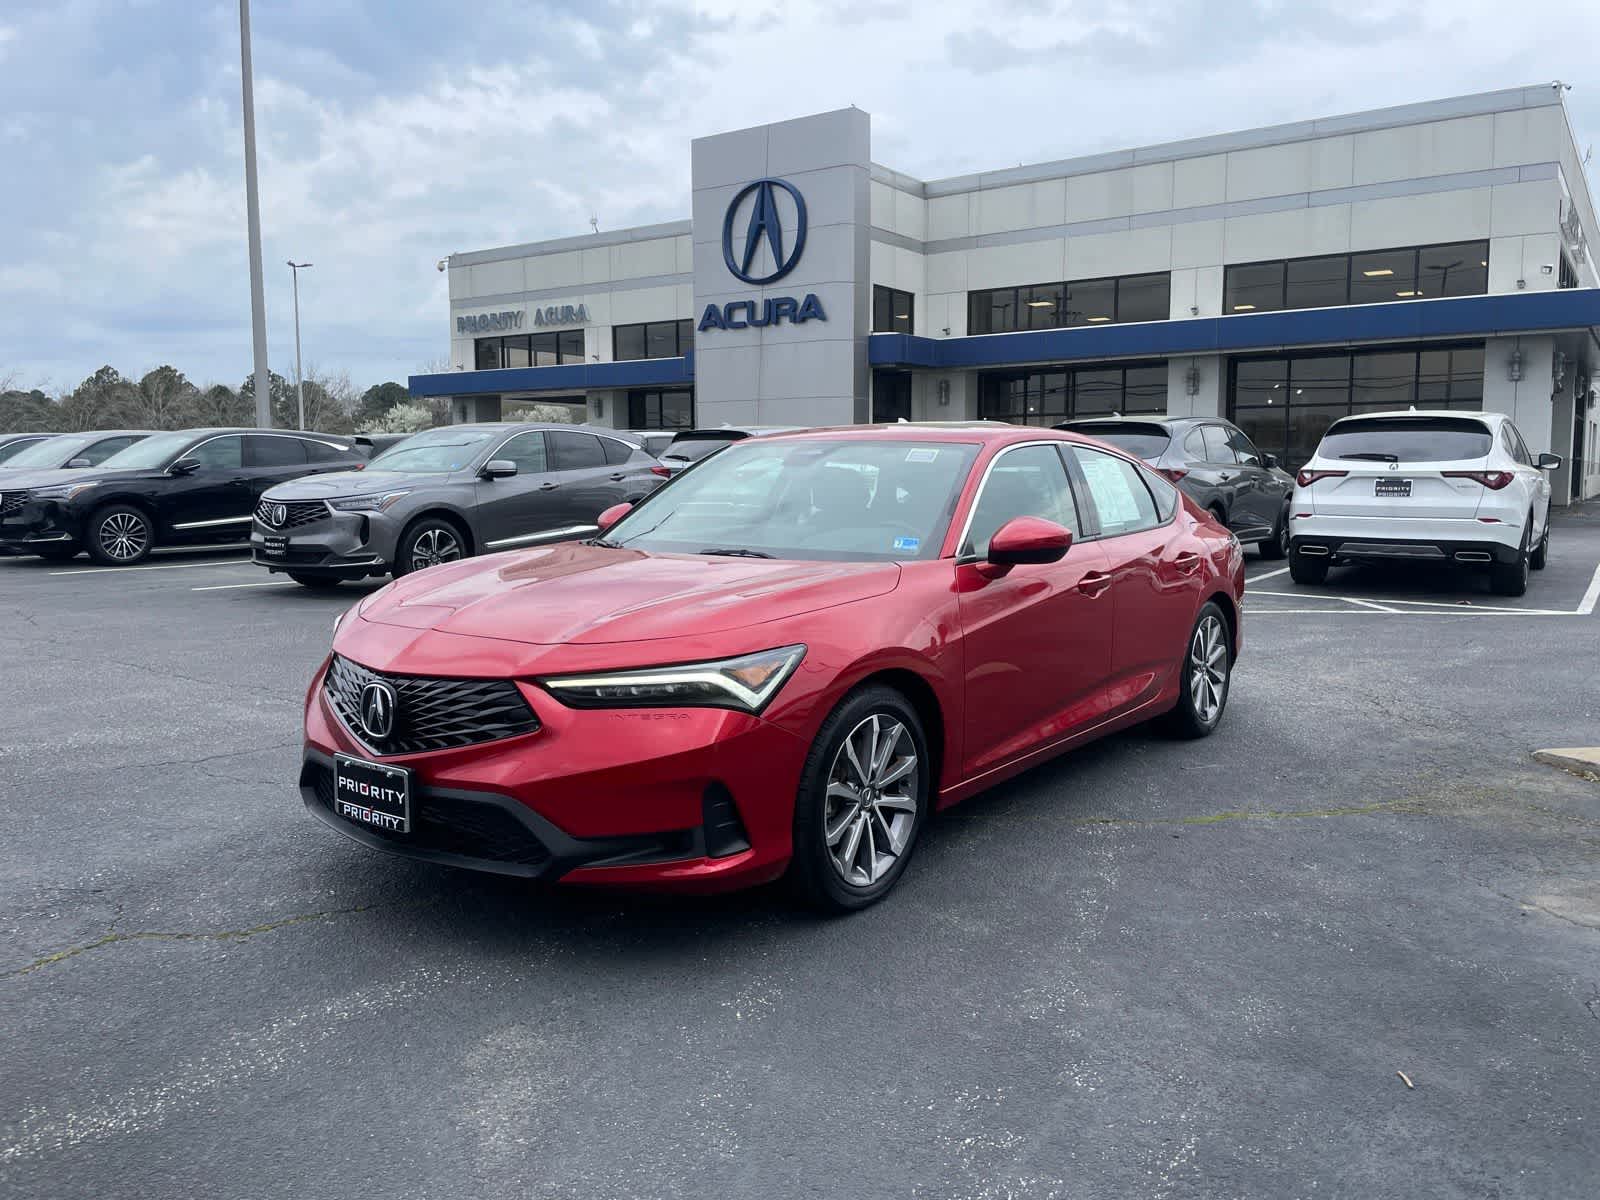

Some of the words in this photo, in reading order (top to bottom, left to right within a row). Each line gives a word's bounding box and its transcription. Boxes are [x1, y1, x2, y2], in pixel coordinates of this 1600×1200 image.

[534, 303, 589, 327] ACURA
[697, 293, 827, 331] ACURA
[608, 713, 692, 721] INTEGRA
[338, 775, 405, 805] PRIORITY
[343, 804, 399, 830] PRIORITY
